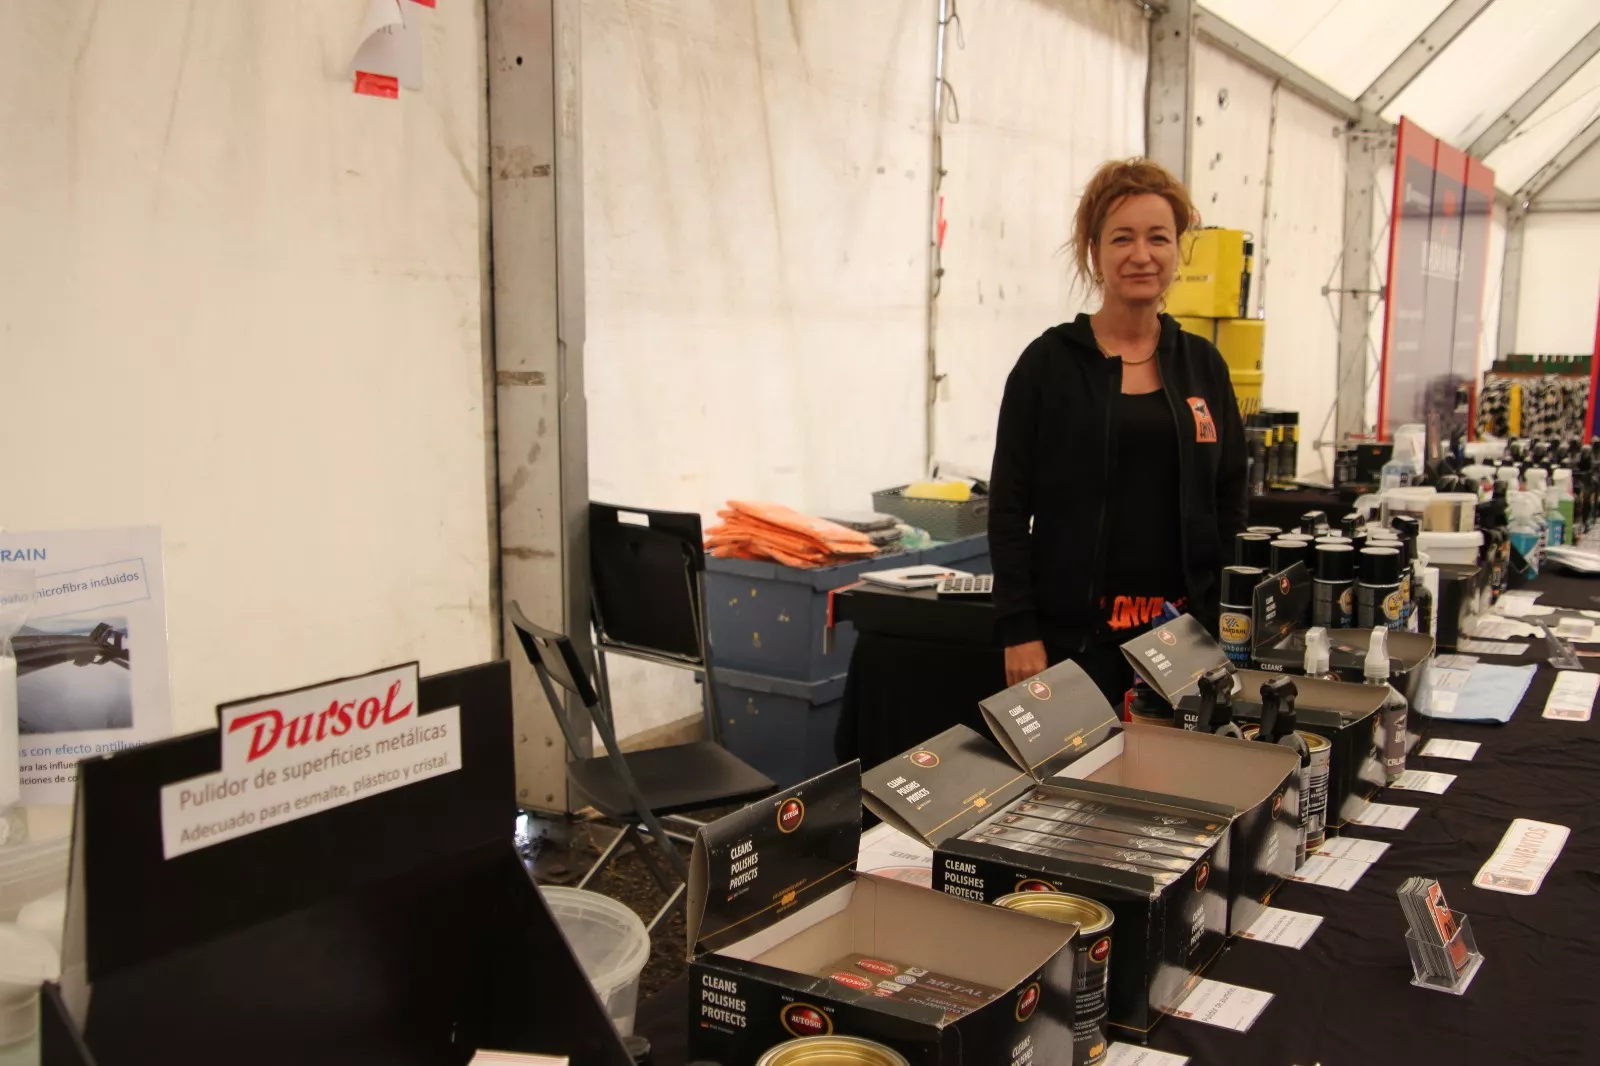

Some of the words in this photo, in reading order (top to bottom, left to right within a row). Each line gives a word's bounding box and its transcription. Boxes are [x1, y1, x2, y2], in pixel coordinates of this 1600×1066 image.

[0, 548, 47, 563] RAIN
[90, 572, 140, 588] incluidos
[1261, 664, 1284, 672] CLEANS
[30, 747, 51, 757] con
[55, 742, 92, 756] efecto
[35, 761, 48, 771] las
[180, 776, 249, 812] Pulidor
[253, 768, 277, 790] de
[281, 744, 371, 782] superficies
[374, 723, 448, 755] metálicas
[54, 773, 65, 783] de
[180, 812, 255, 846] Adecuado
[259, 801, 291, 824] para
[353, 765, 400, 795] plástico
[402, 766, 411, 781] y
[730, 840, 753, 860] CLEANS
[730, 852, 759, 876] POLISHES
[945, 859, 977, 874] CLEANS
[729, 866, 759, 891] PROTECTS
[944, 872, 985, 889] POLISHES
[944, 884, 985, 901] PROTECTS
[702, 974, 737, 994] CLEANS
[702, 990, 747, 1012] POLISHES
[702, 1005, 747, 1028] PROTECTS
[791, 1015, 821, 1029] AUTOSOL
